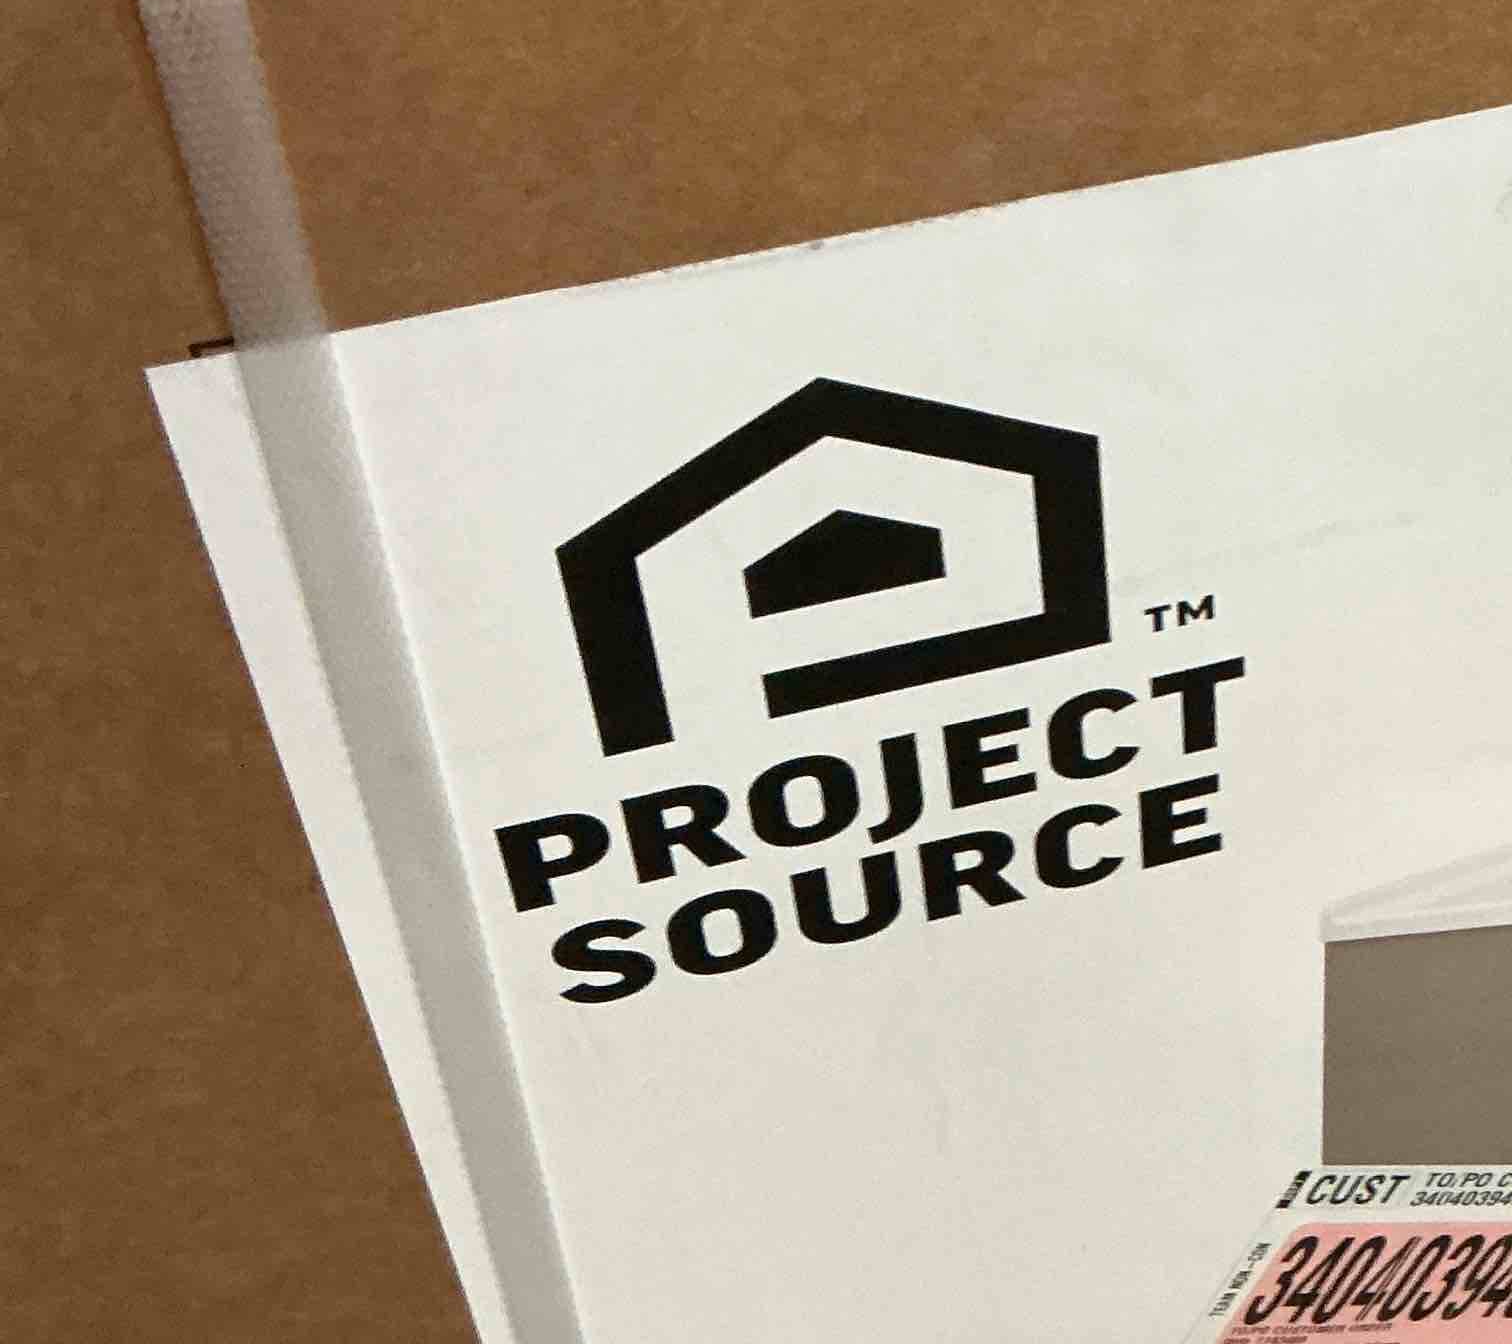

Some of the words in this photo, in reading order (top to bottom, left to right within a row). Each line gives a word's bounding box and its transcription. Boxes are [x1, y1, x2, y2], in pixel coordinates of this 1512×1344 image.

[1144, 594, 1215, 632] TM
[494, 656, 1246, 913] PROJECT
[551, 774, 1223, 1004] SOURCE
[1306, 1174, 1411, 1205] CUST
